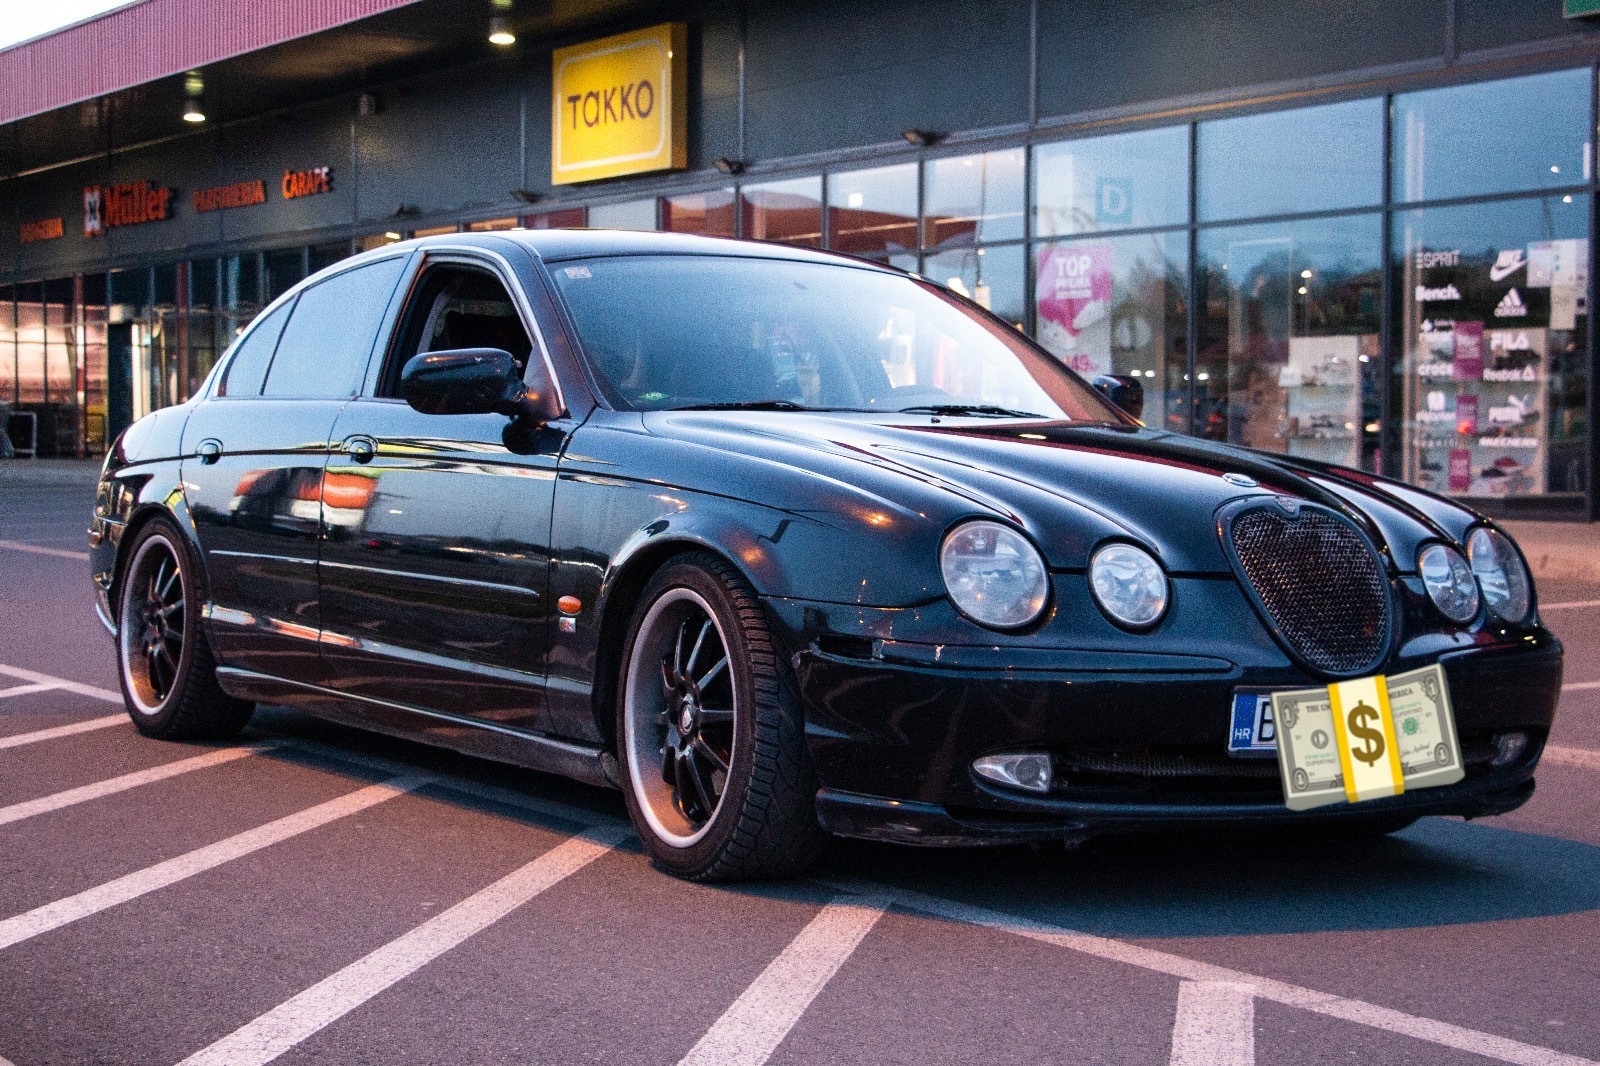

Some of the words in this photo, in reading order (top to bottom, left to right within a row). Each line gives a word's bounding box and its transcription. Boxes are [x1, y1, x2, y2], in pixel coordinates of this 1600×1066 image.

[1055, 255, 1092, 279] TOP
[1416, 249, 1461, 270] ESPRIT
[1494, 305, 1528, 318] adidas
[1490, 331, 1530, 351] FILA
[1234, 727, 1251, 740] HR
